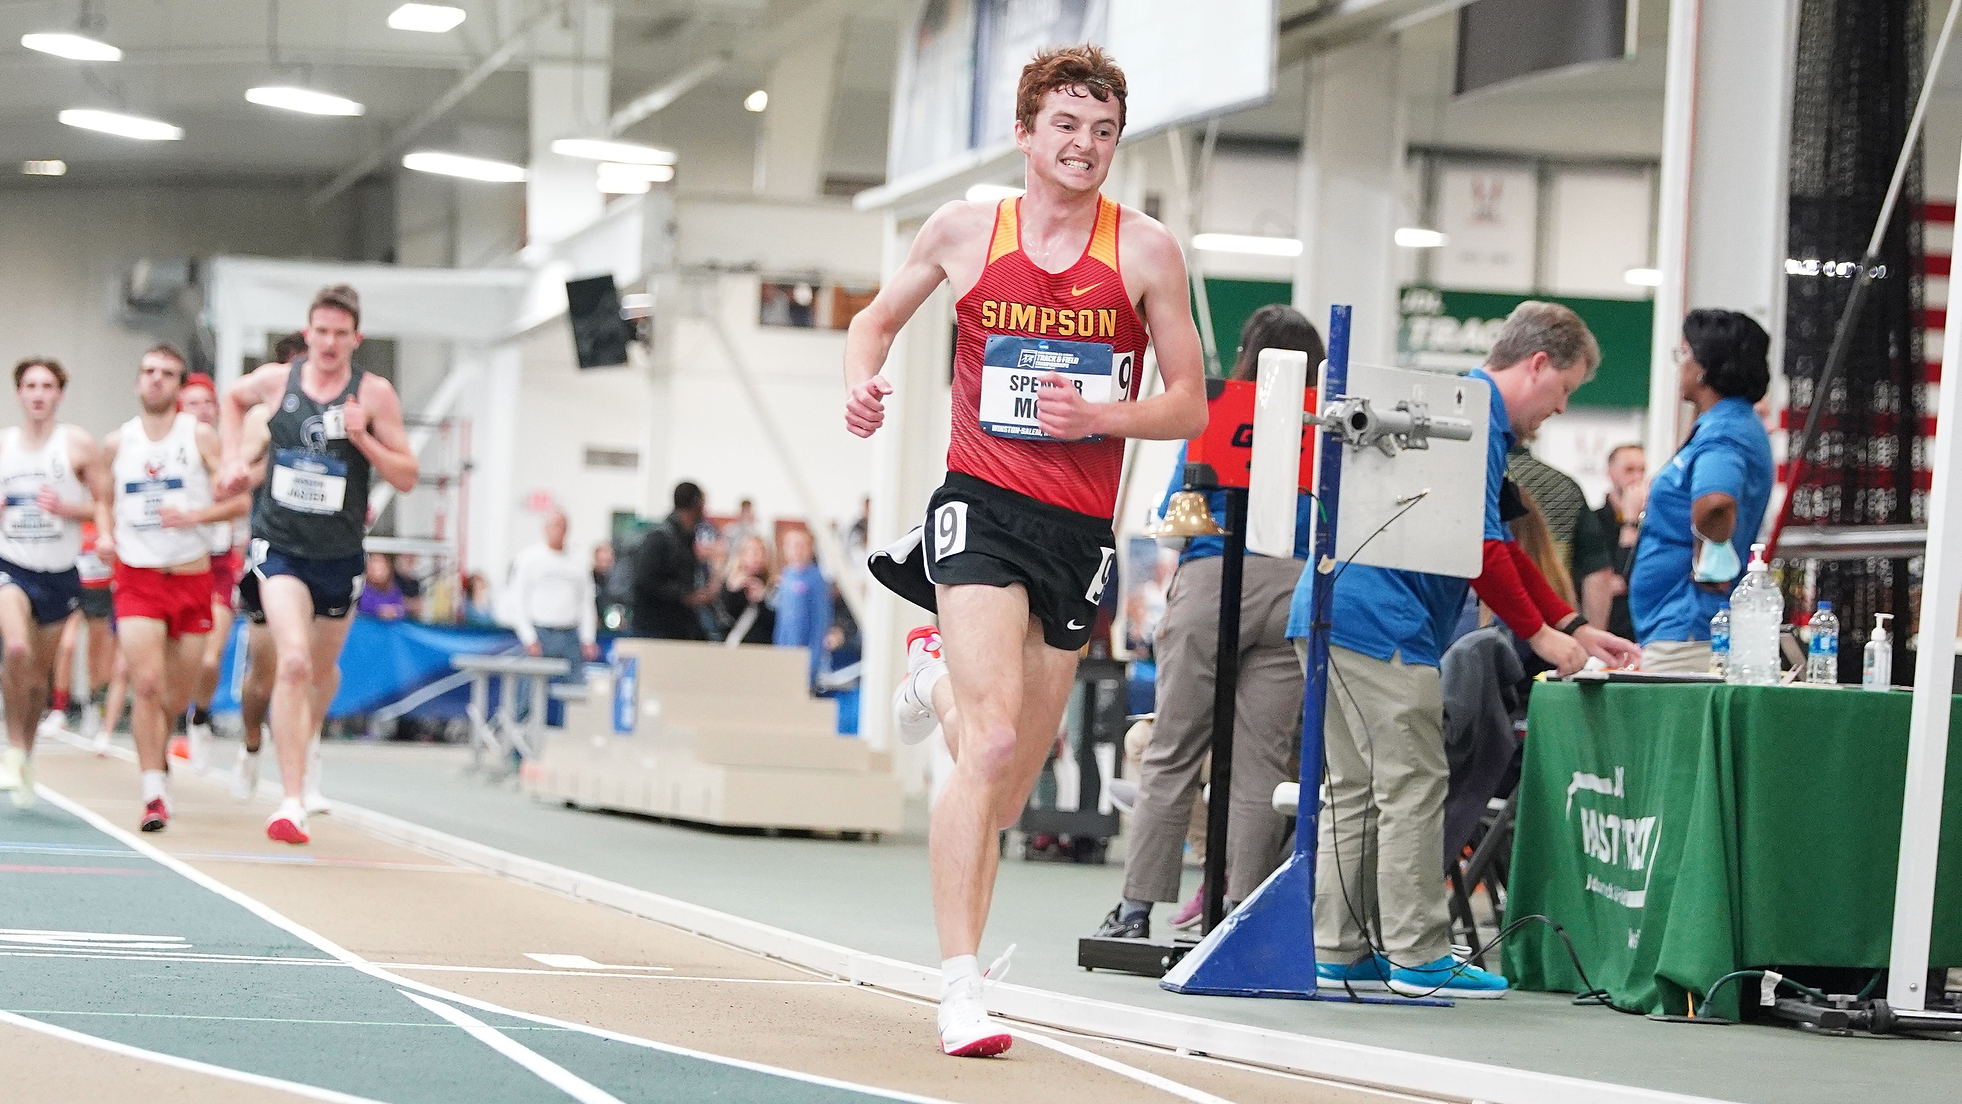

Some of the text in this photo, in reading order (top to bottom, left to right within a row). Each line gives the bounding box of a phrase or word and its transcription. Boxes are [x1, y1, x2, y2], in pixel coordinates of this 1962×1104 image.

[981, 300, 1118, 337] SIMPSON
[1036, 354, 1057, 363] TRACK
[1062, 357, 1080, 365] FIELD
[1118, 356, 1132, 402] 9
[938, 506, 958, 556] 9
